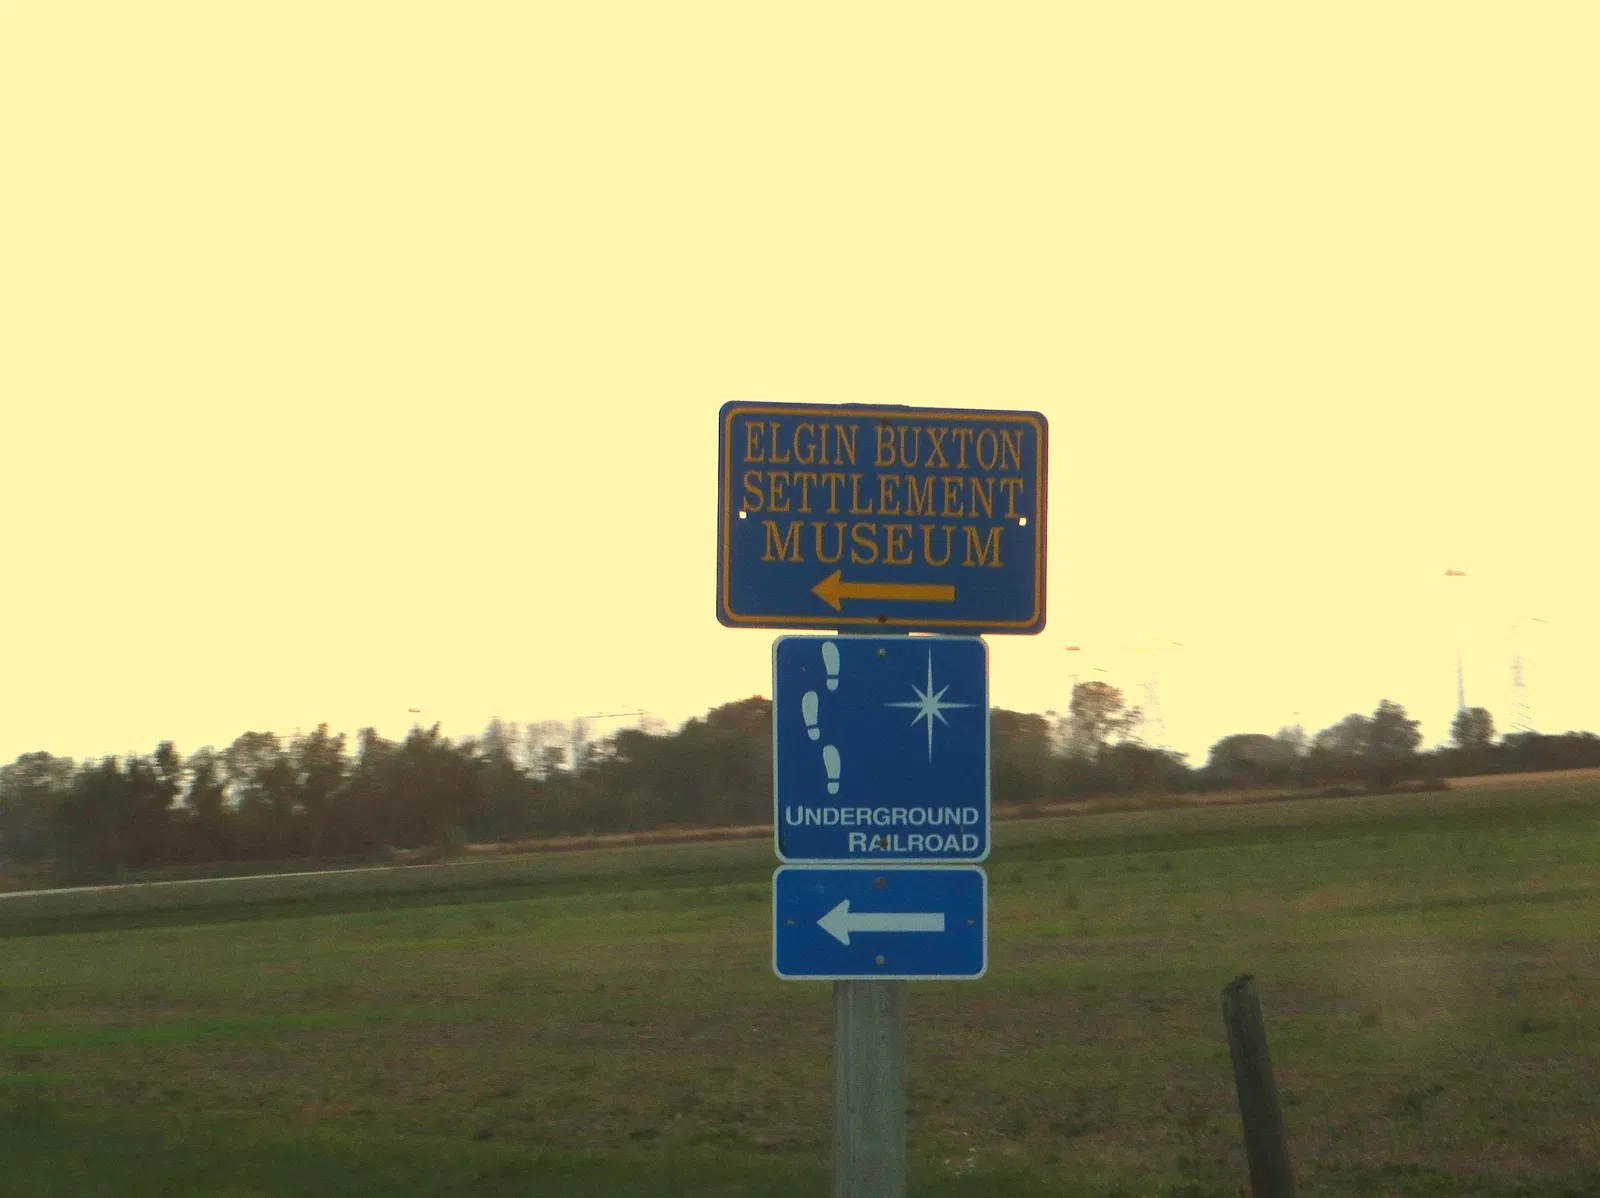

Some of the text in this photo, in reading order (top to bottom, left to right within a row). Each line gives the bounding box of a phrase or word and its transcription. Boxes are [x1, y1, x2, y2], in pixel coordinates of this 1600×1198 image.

[744, 421, 1024, 471] ELGIN BUXTON
[742, 469, 1024, 519] SETTLEMENT
[760, 520, 1005, 568] MUSEUM
[785, 805, 979, 826] UNDERGROUND
[848, 832, 979, 852] RAILROAD
